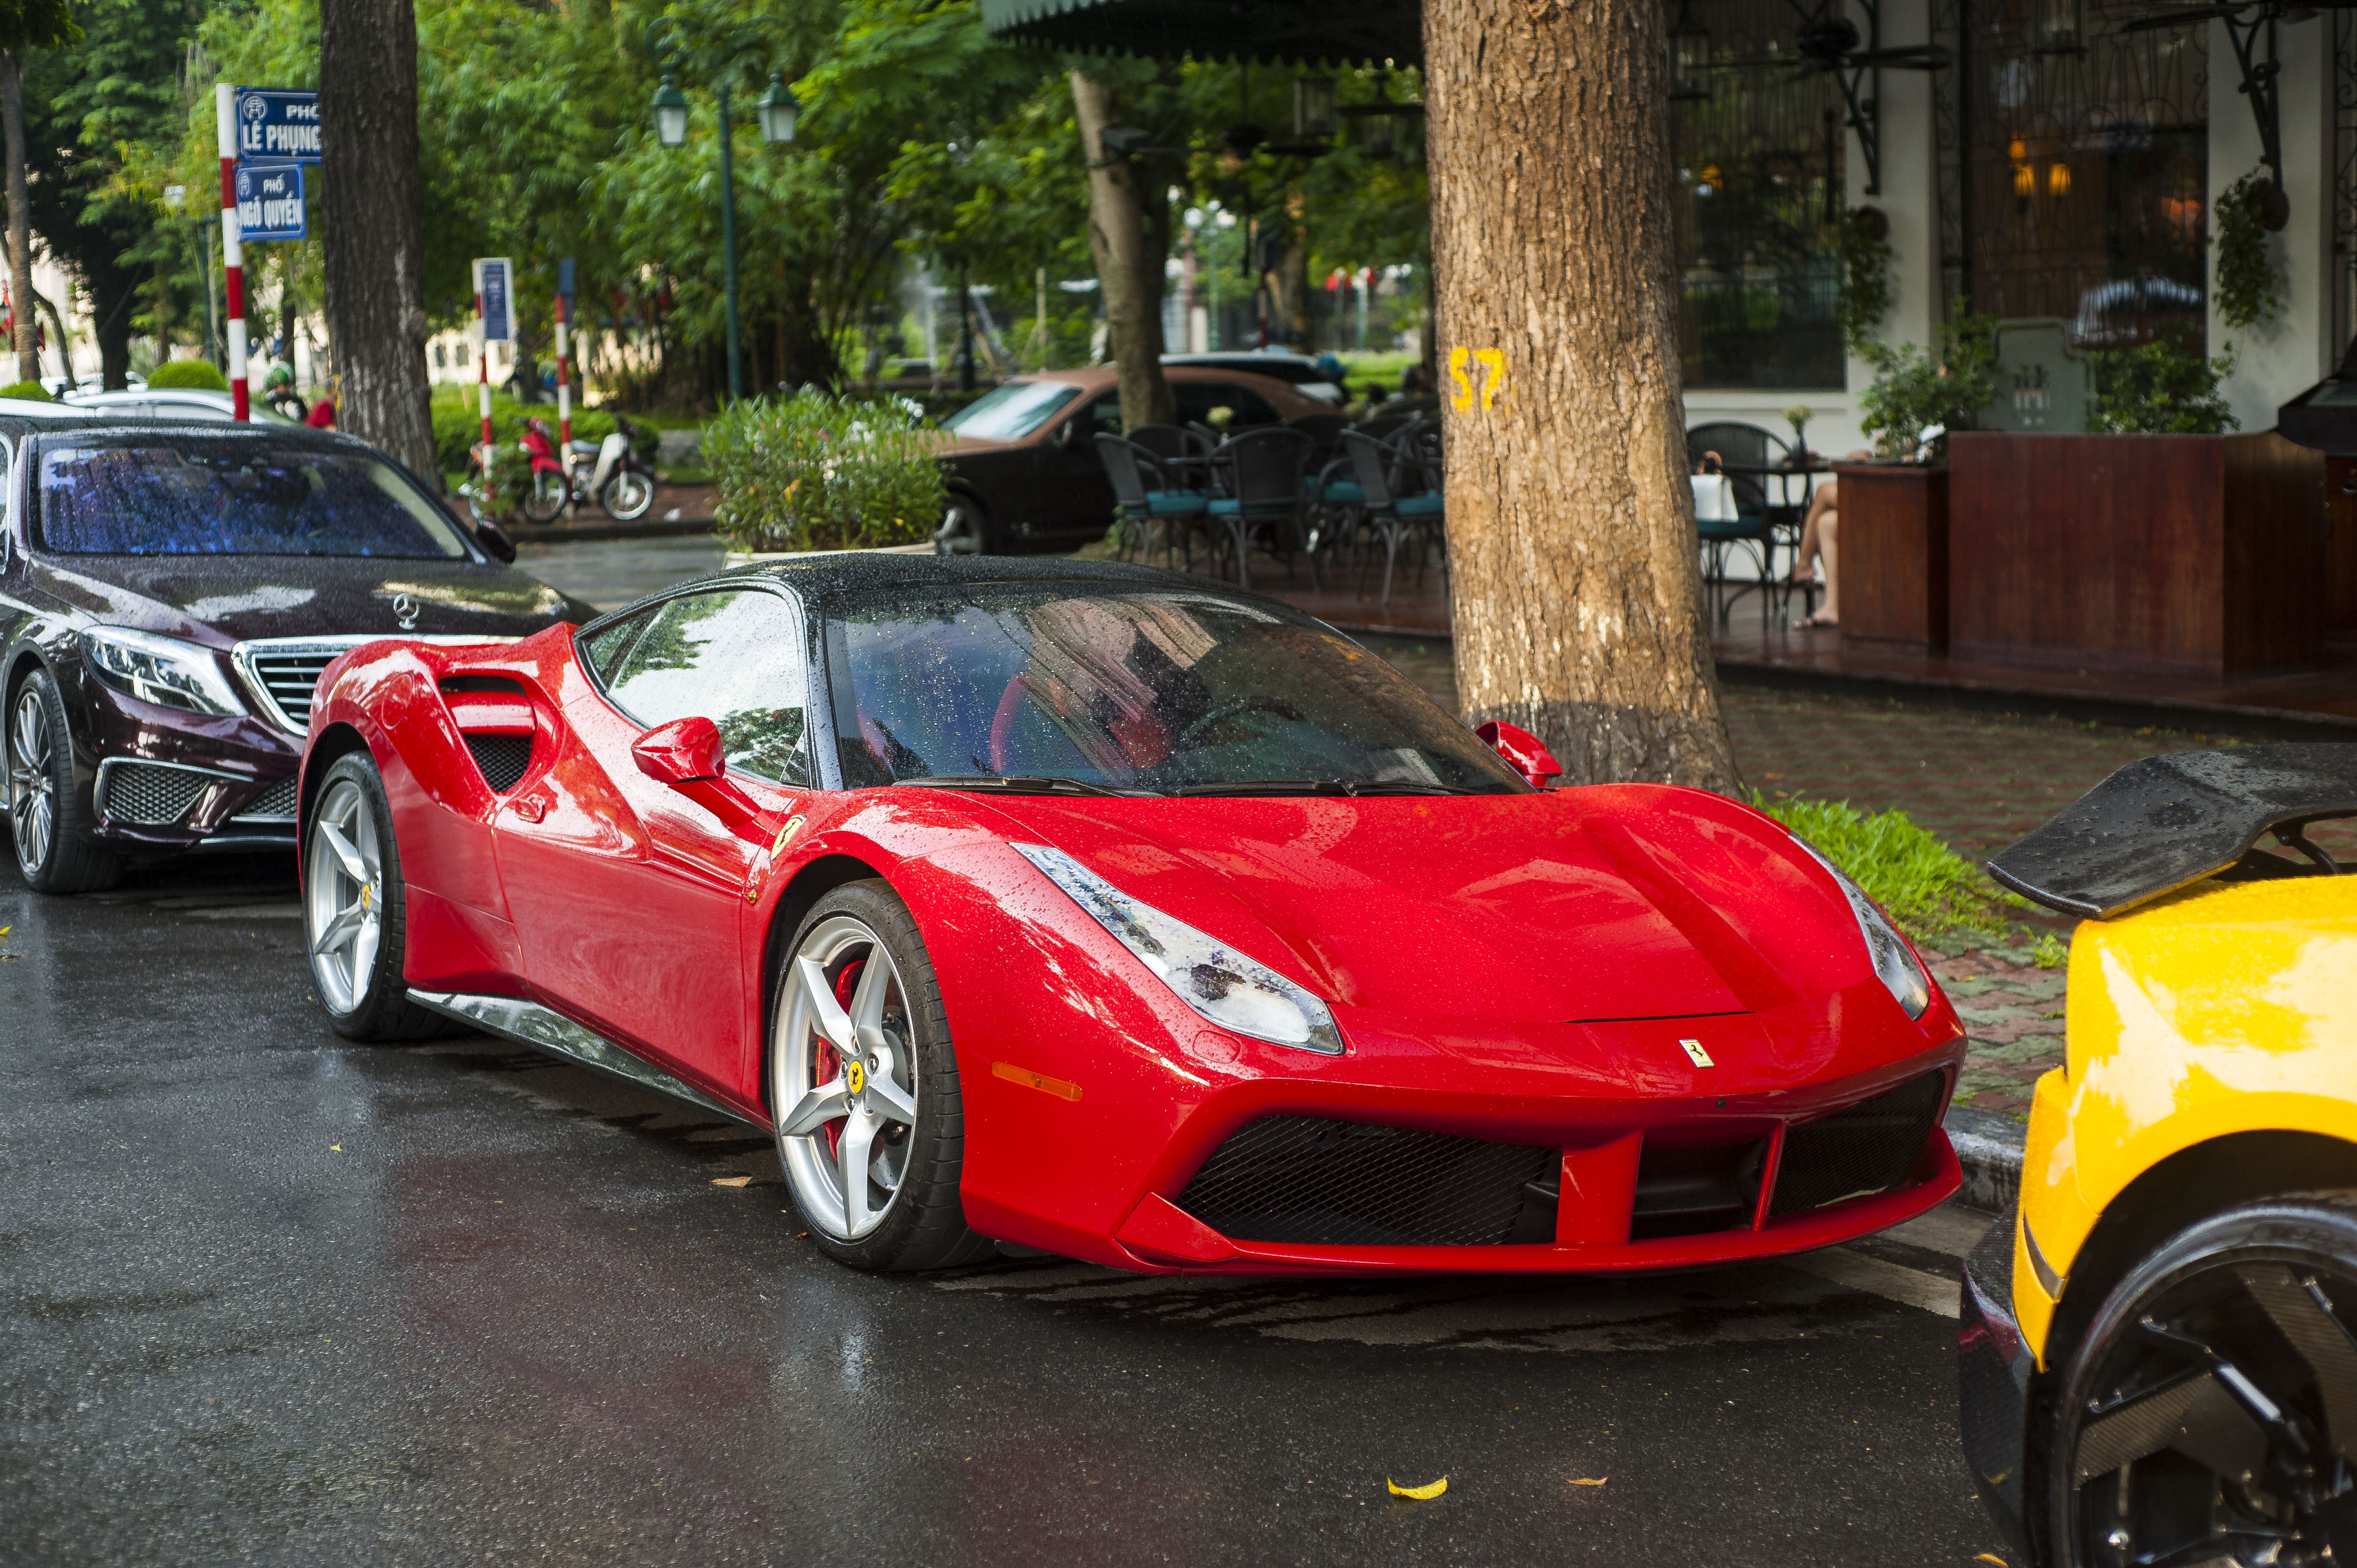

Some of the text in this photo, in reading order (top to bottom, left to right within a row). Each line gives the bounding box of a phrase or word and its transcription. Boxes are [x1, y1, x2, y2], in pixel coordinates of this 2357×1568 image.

[243, 120, 263, 151] LÊ
[263, 173, 285, 194] PHỐ
[238, 195, 263, 228] NGÔ
[1450, 346, 1504, 412] 57
